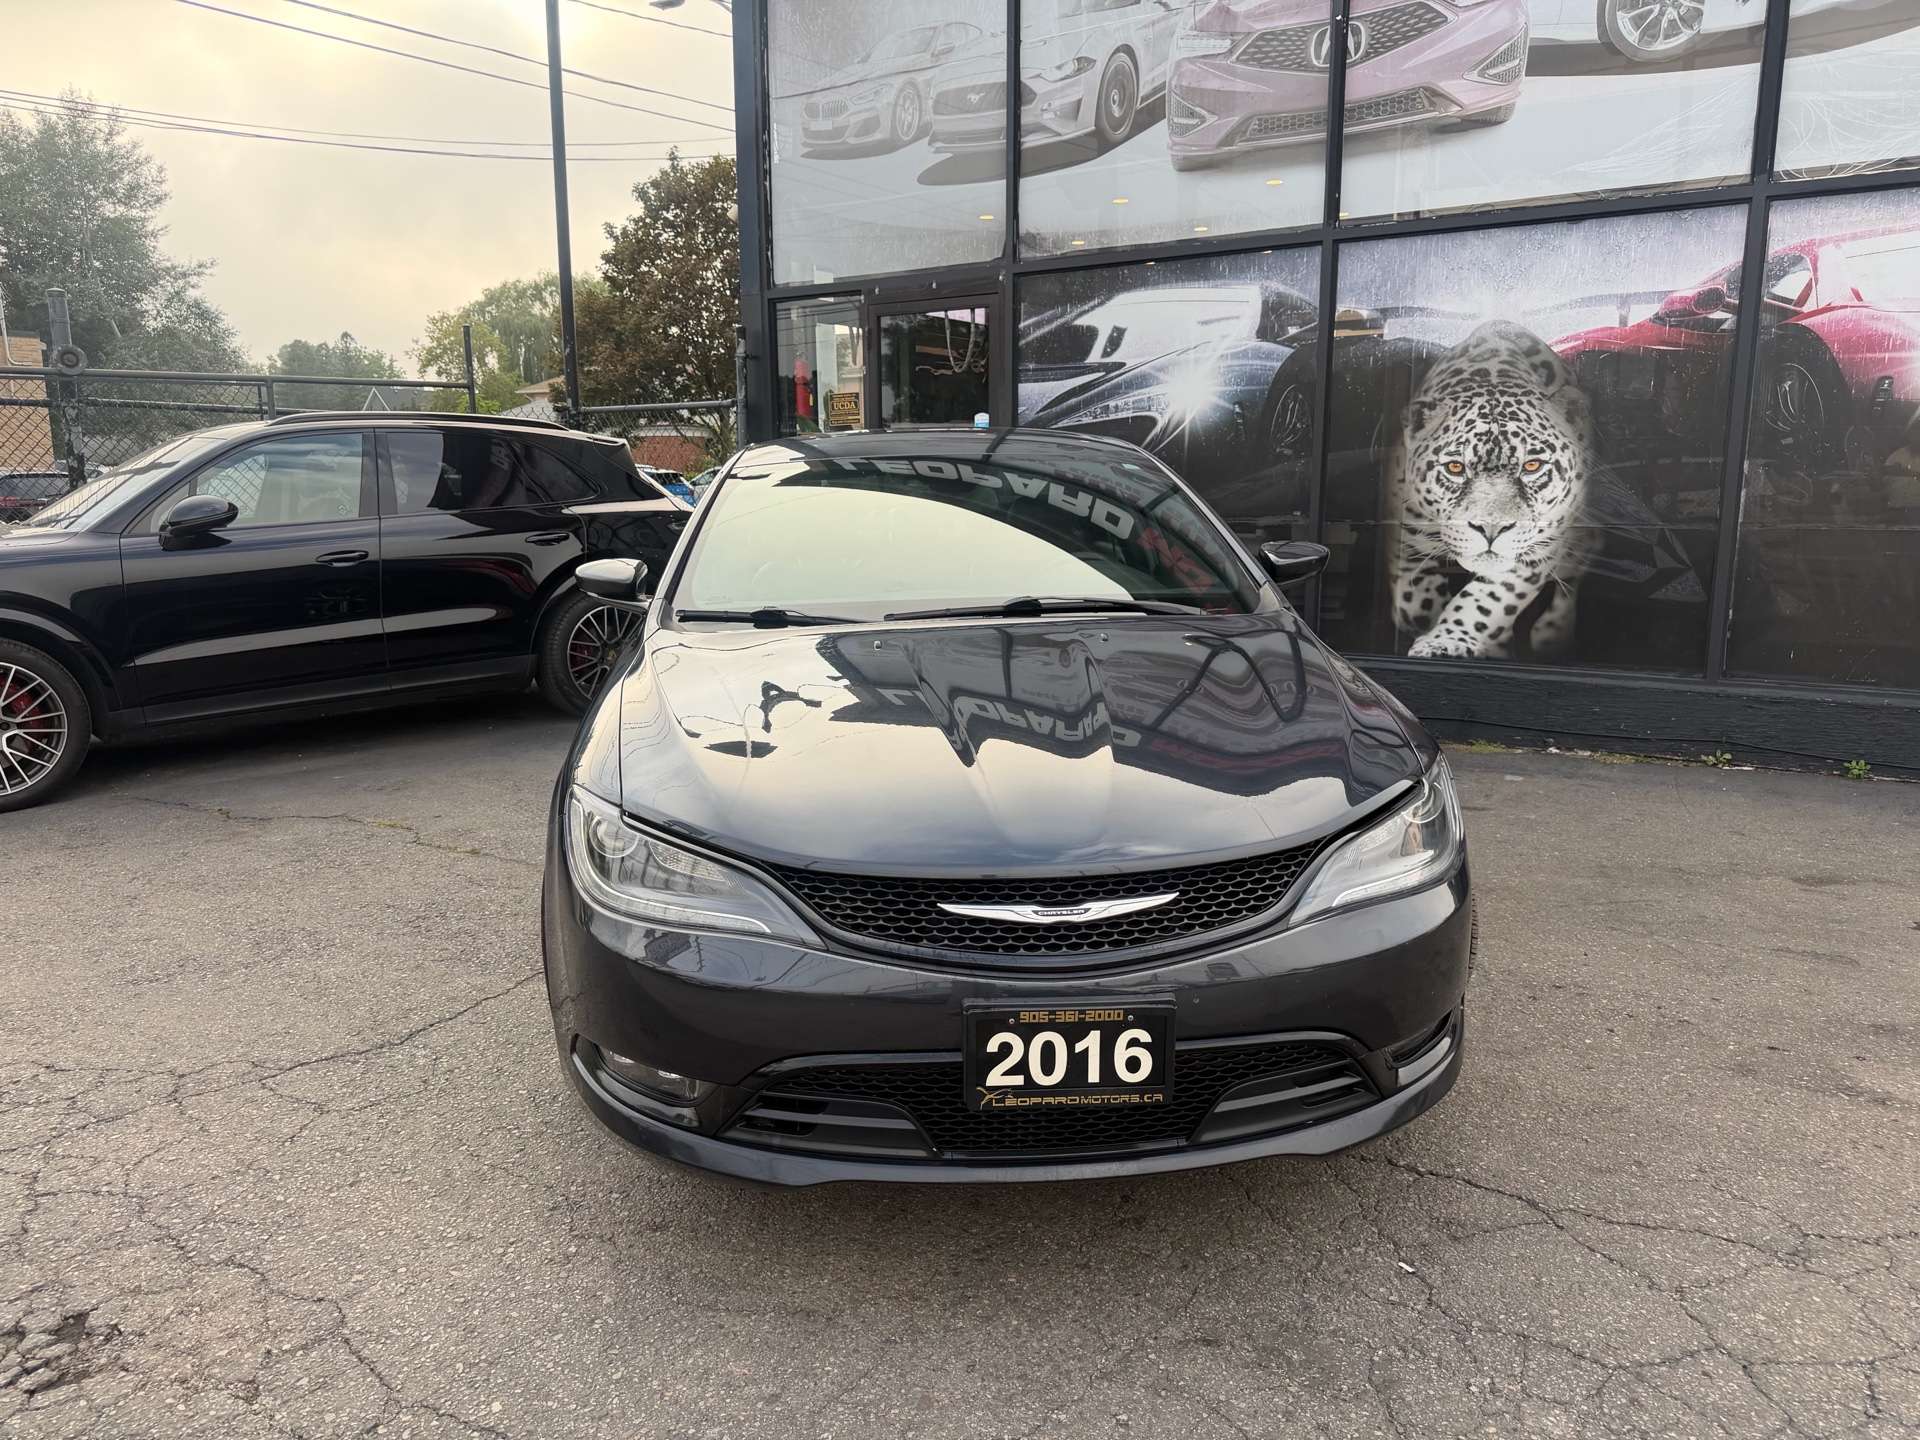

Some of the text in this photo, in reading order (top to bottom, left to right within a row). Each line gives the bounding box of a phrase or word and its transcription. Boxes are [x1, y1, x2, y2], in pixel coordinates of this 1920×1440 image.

[833, 401, 857, 410] UCDA
[1019, 1009, 1124, 1023] 905-361-2000
[985, 1028, 1153, 1087] 2016
